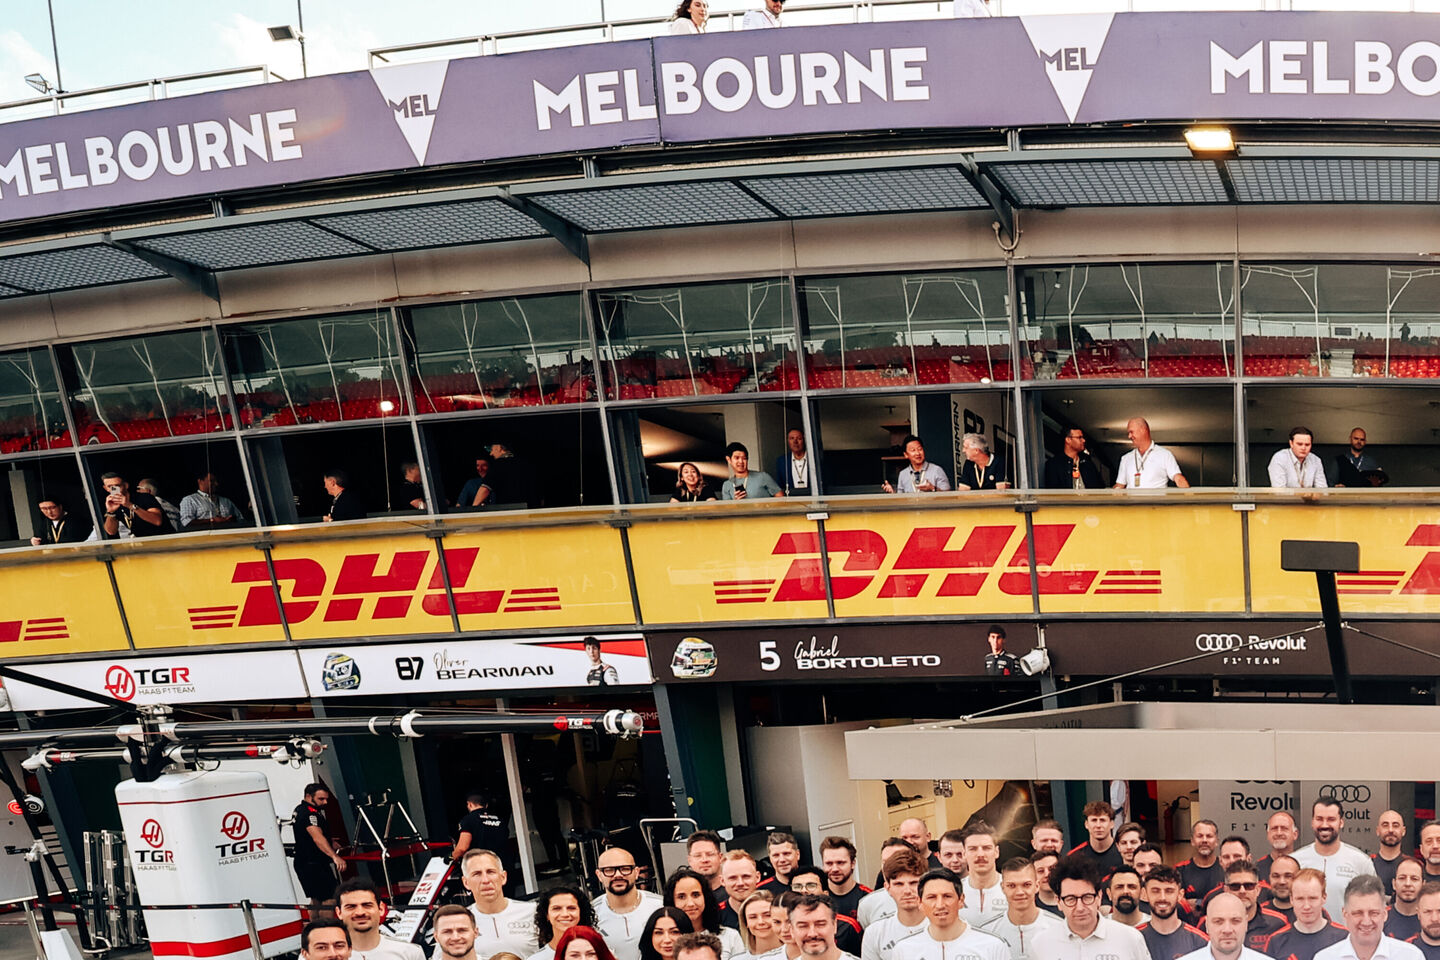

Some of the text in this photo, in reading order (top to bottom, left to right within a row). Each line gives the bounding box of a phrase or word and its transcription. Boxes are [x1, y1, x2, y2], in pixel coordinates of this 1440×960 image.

[1038, 47, 1096, 71] MEL
[532, 46, 931, 131] MELBOURNE
[388, 92, 439, 119] MEL
[0, 109, 303, 200] MELBOURNE
[772, 524, 1099, 602] DHL
[231, 547, 505, 628] DHL
[794, 635, 839, 660] Gabriel
[1249, 635, 1306, 650] Revolut
[433, 649, 468, 671] Oliver
[759, 640, 781, 671] 5
[797, 655, 941, 670] BORTOLETO
[1246, 657, 1280, 665] TEAM
[134, 667, 190, 685] TGR
[395, 656, 424, 681] 87
[436, 665, 554, 680] BEARMAN
[138, 687, 161, 695] HAAS
[173, 686, 195, 694] TEAM
[135, 850, 174, 863] TGR
[215, 838, 265, 857] TGR
[219, 858, 239, 866] HAAS
[249, 852, 269, 861] TEAM
